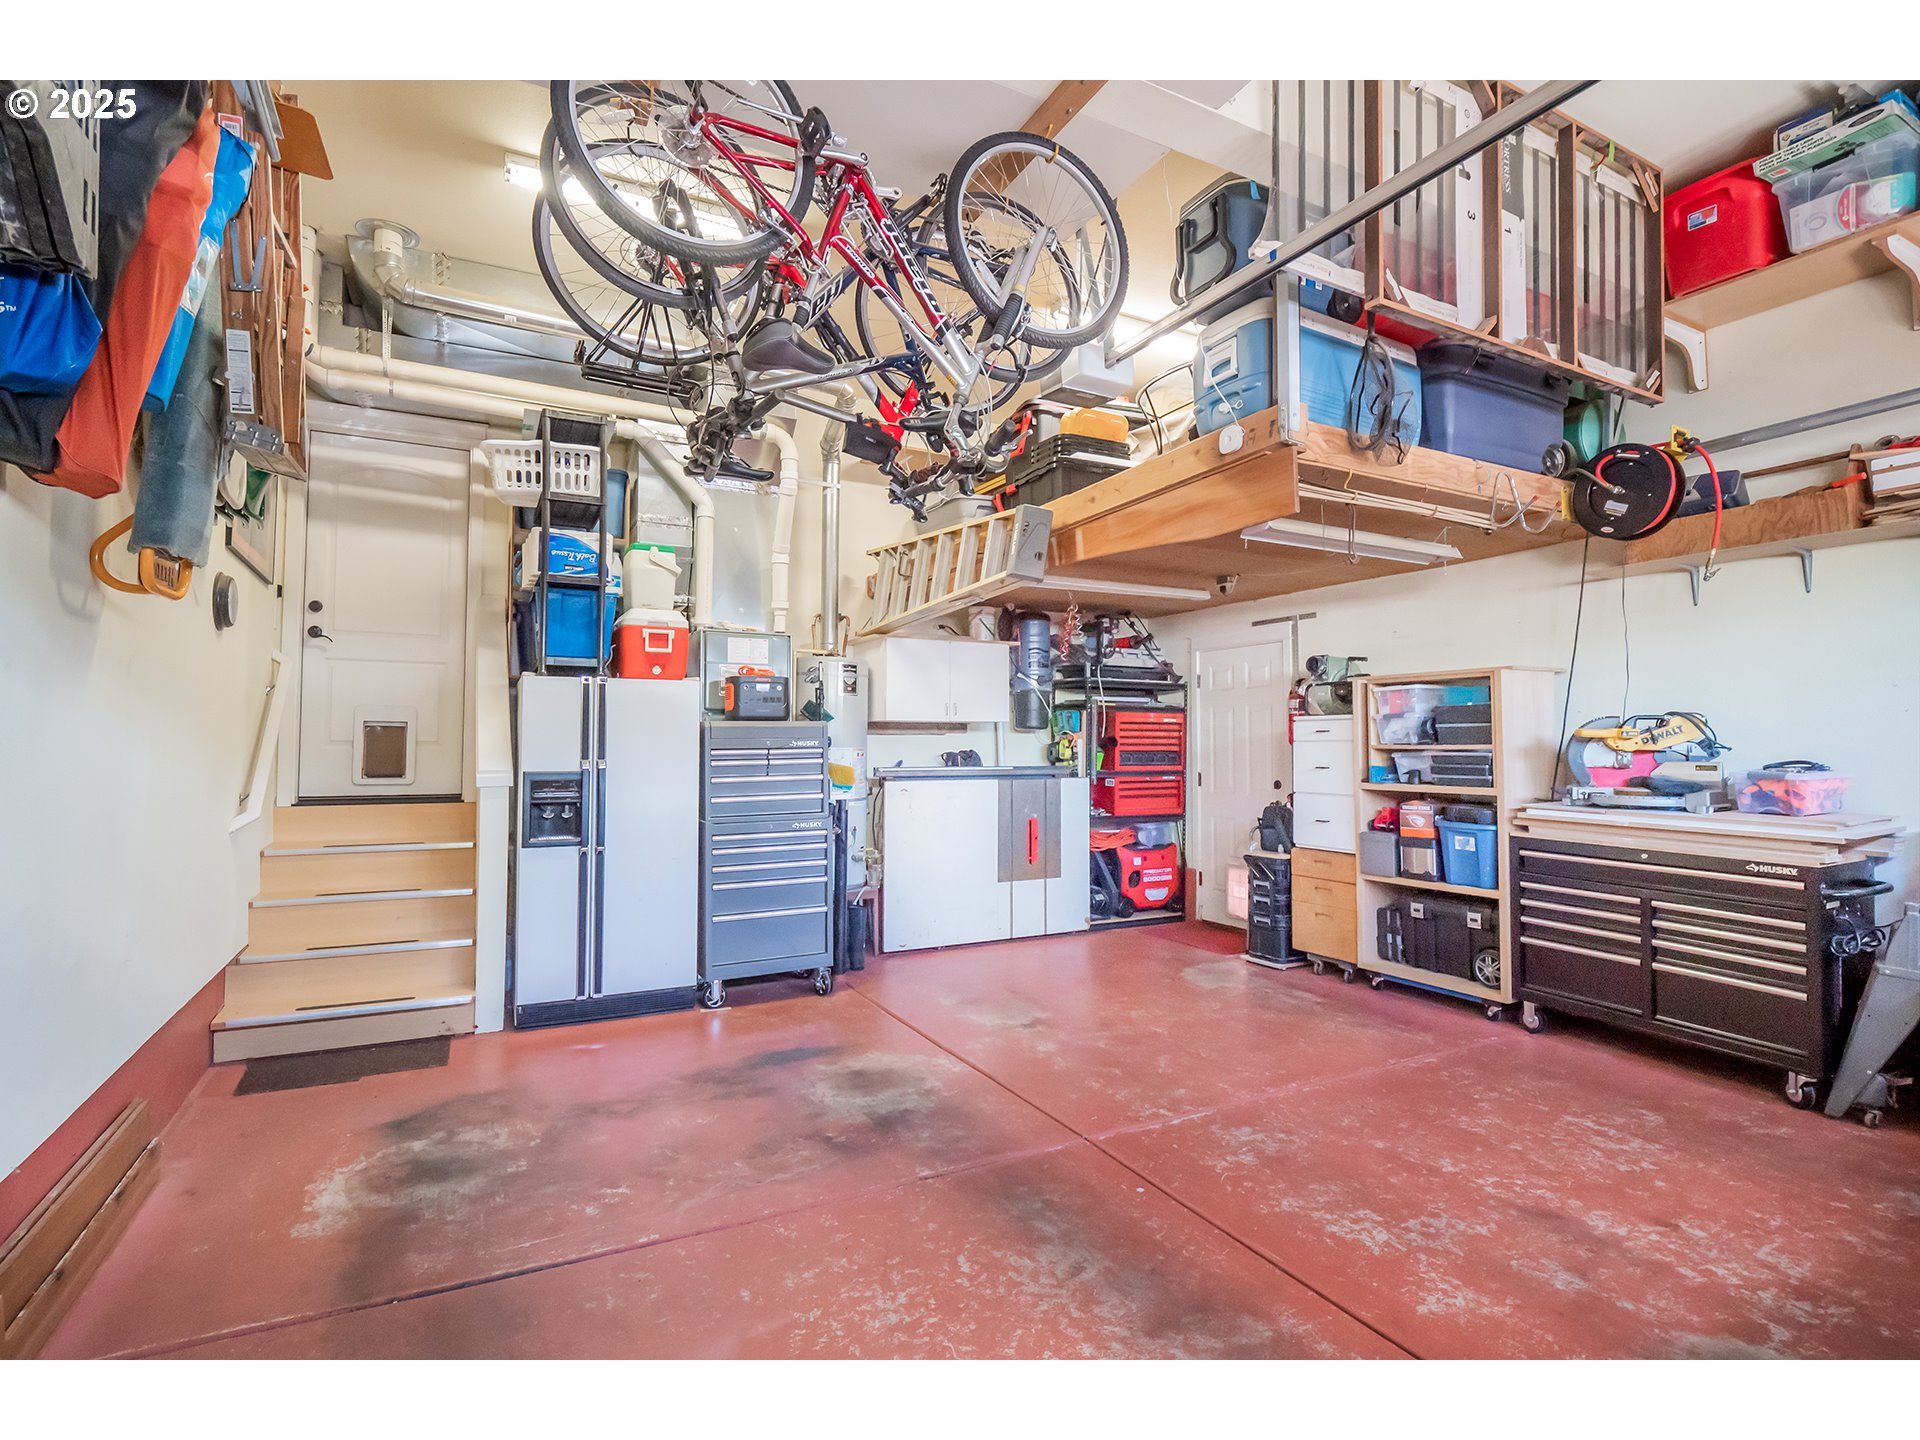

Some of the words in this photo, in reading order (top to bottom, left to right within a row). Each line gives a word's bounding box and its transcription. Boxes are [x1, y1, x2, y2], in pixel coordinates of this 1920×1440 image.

[1467, 210, 1476, 221] 3
[1504, 226, 1512, 235] 1
[551, 549, 575, 561] Tissue
[575, 552, 597, 563] Bath
[1759, 864, 1799, 876] HUSKY
